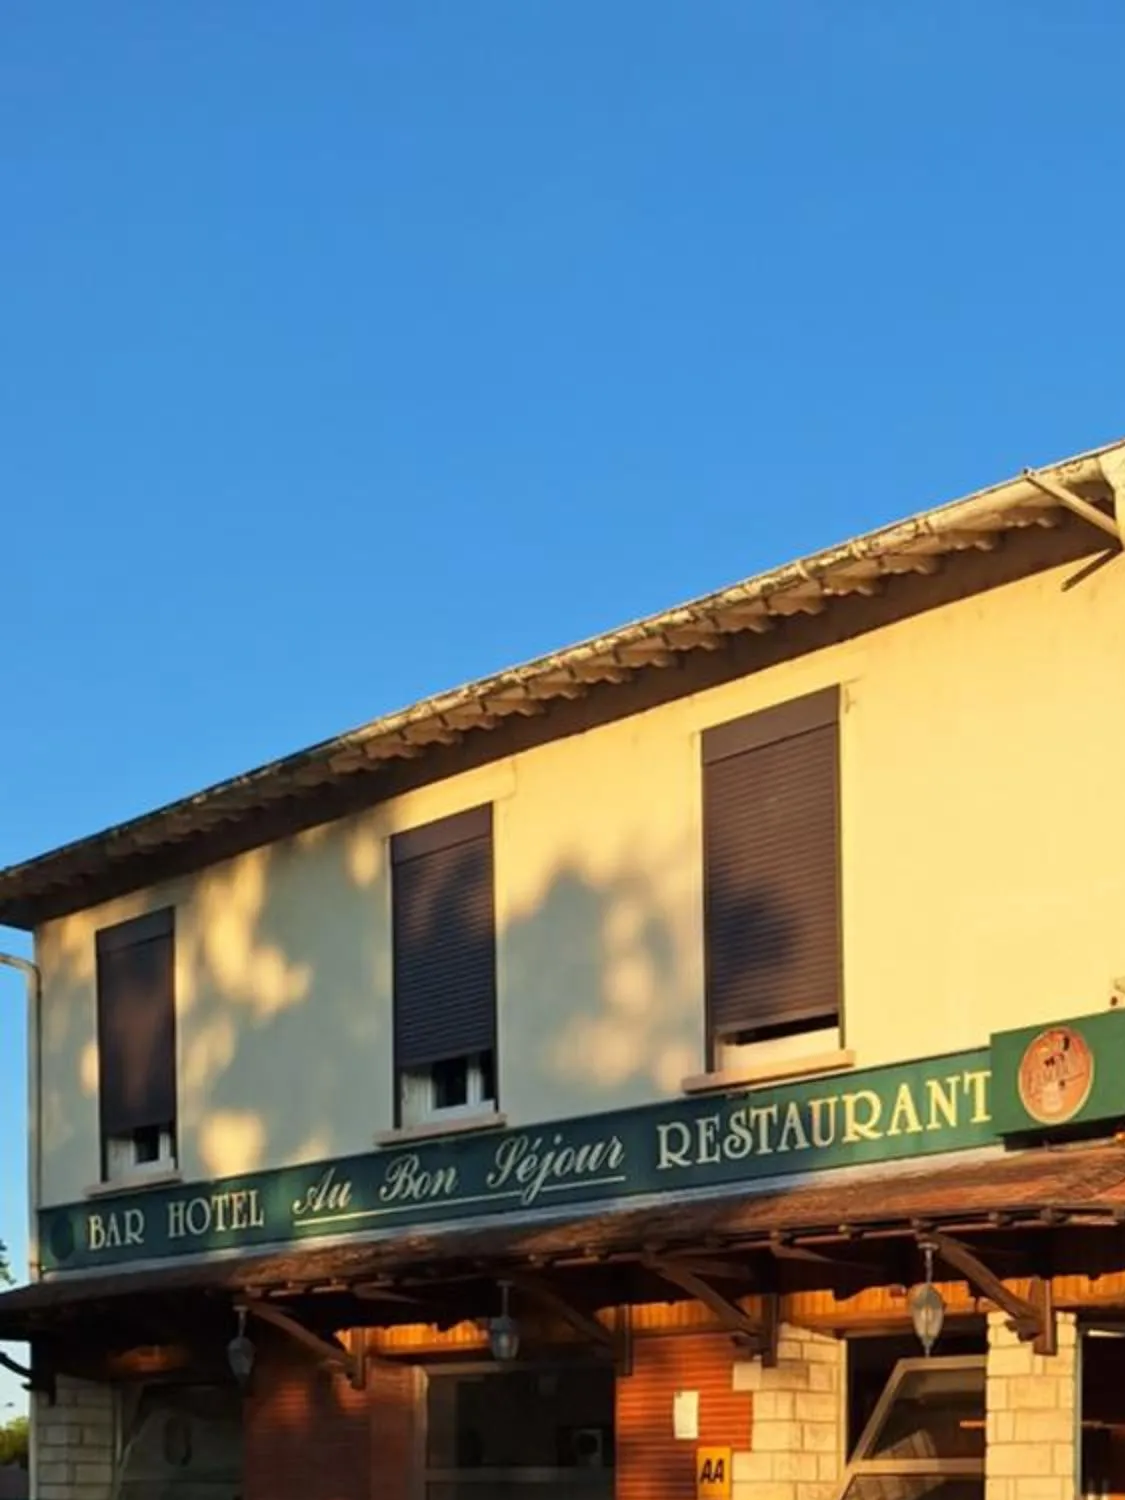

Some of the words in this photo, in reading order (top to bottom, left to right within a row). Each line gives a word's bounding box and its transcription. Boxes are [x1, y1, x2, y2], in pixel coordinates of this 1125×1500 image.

[656, 1069, 992, 1170] RESTAURANT
[293, 1167, 351, 1216] Au
[379, 1153, 456, 1202] Bon
[486, 1131, 626, 1206] Séjour
[88, 1207, 145, 1250] BAR
[168, 1188, 265, 1239] HOTEL
[700, 1457, 725, 1484] AA
